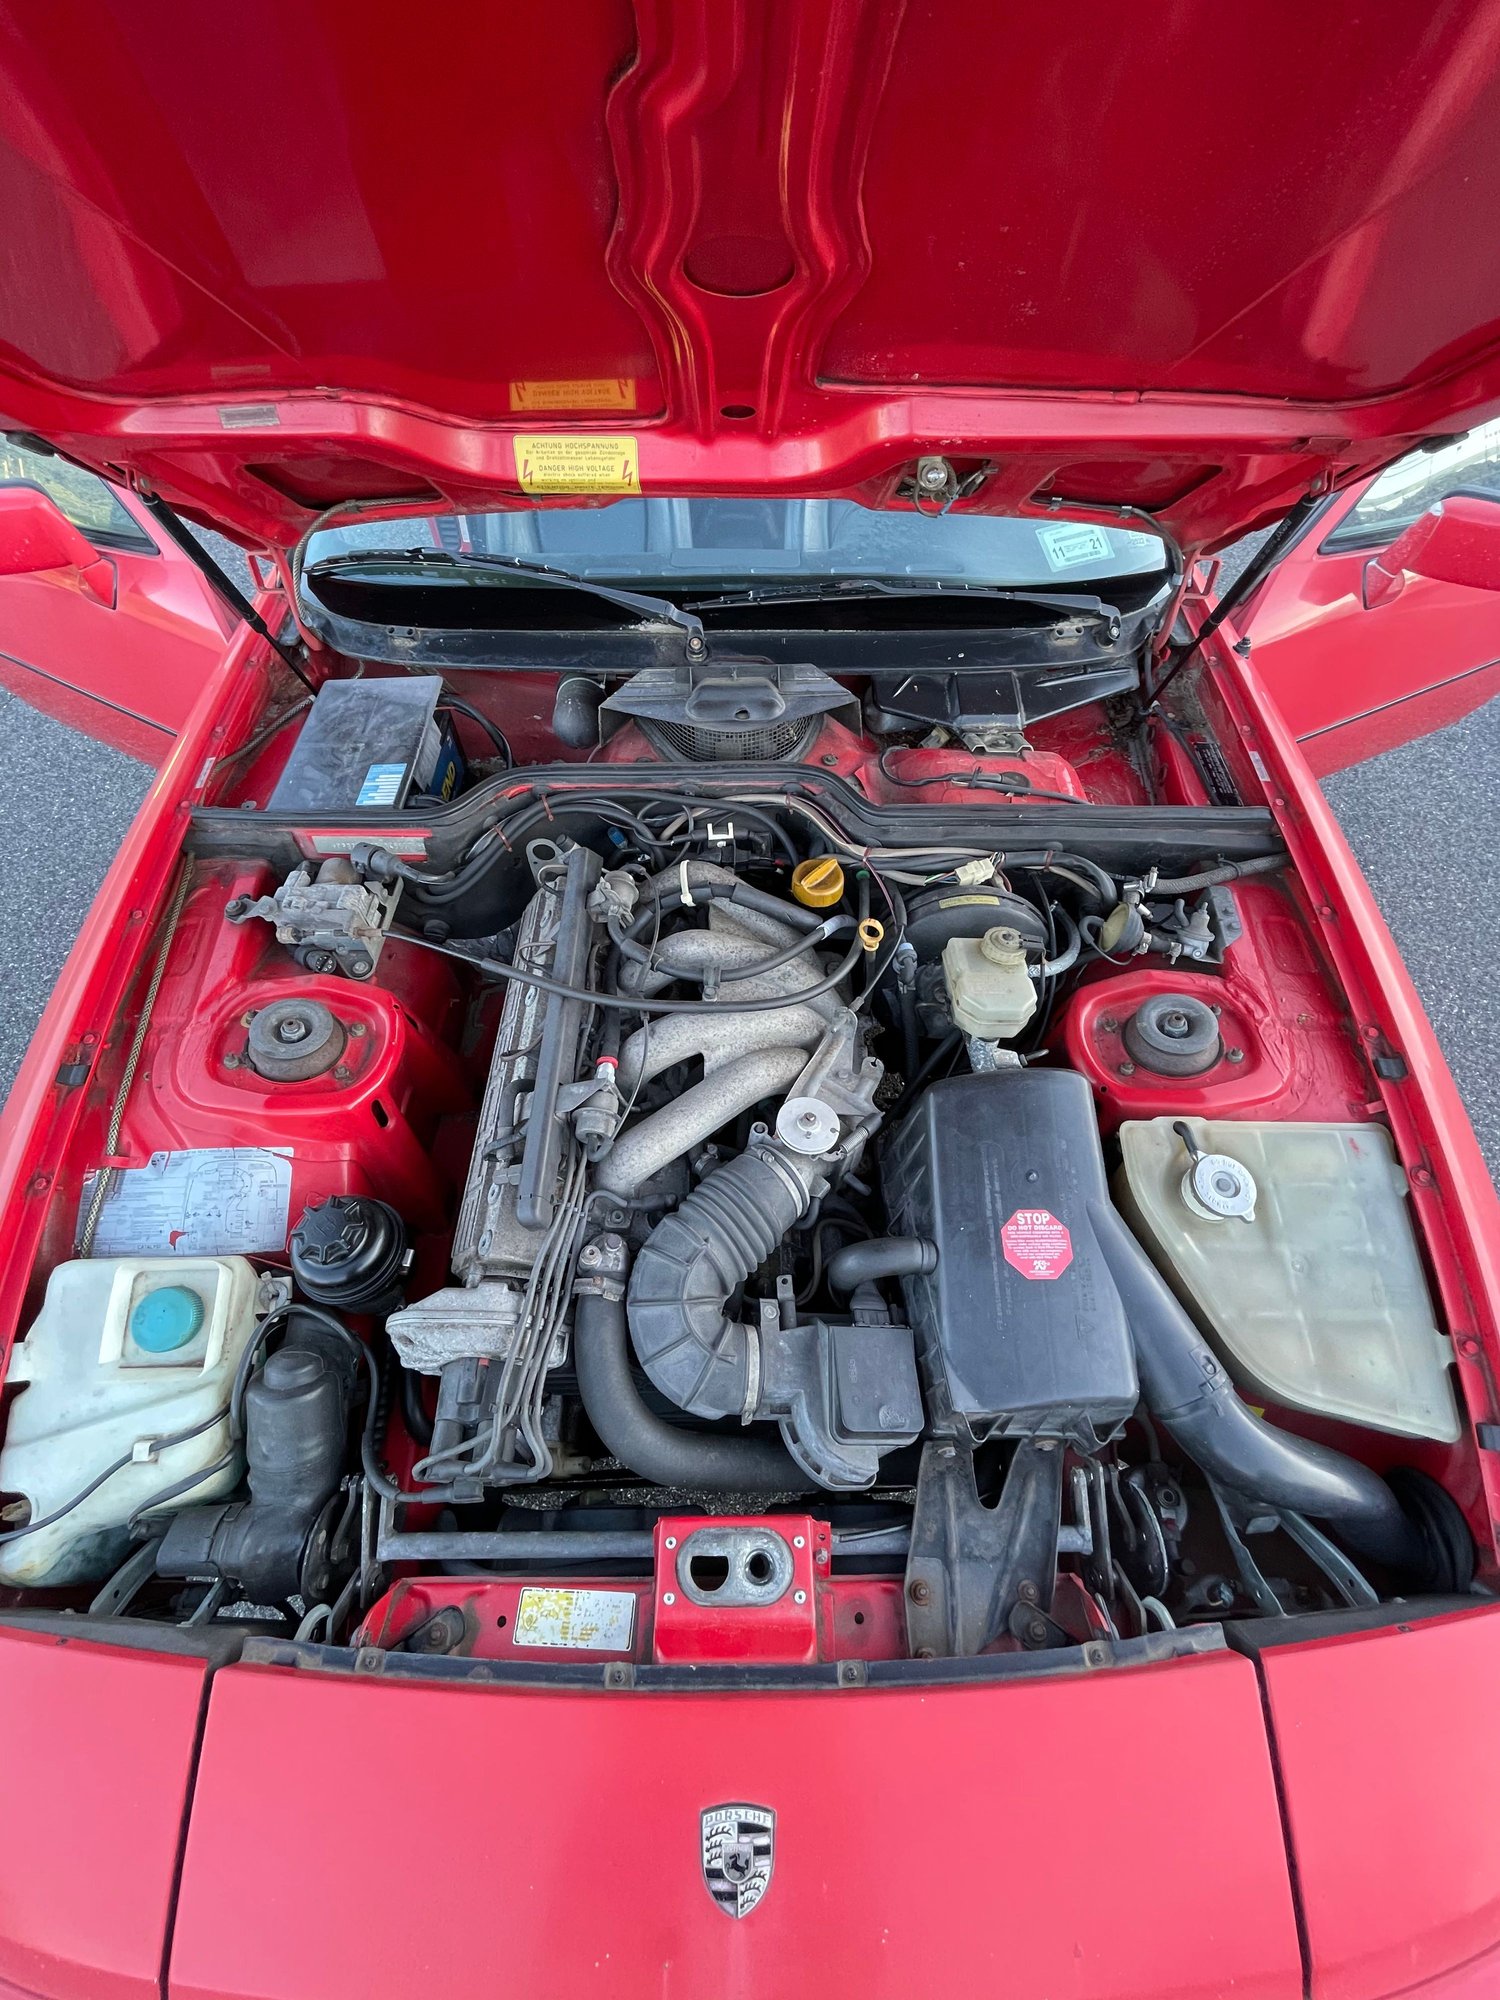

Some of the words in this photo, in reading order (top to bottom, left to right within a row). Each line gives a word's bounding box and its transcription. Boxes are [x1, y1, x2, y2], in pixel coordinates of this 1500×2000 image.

[532, 442, 562, 450] ACHTUNG
[565, 442, 619, 450] HOCHSPANNUNG
[539, 464, 566, 472] DANGER
[1089, 536, 1103, 550] 21
[1052, 545, 1066, 559] 11
[1016, 1213, 1050, 1225] STOP
[705, 1810, 770, 1824] PORSCHE
